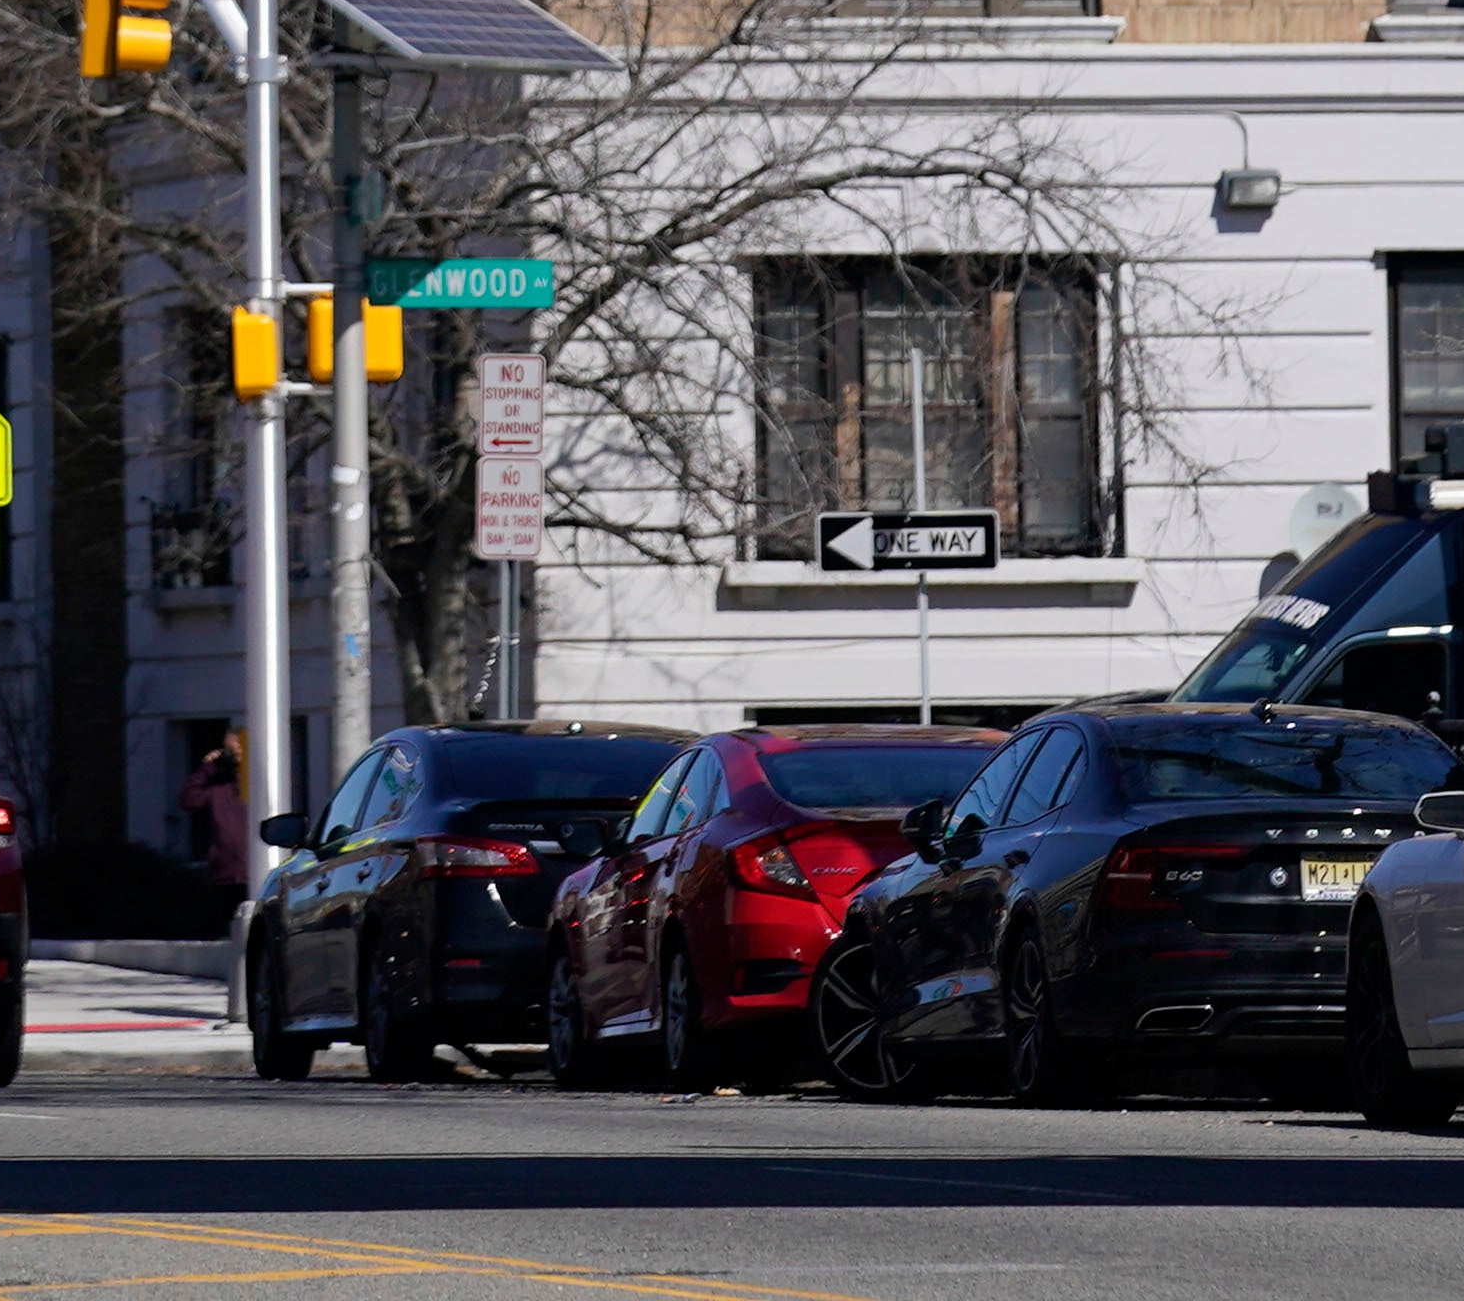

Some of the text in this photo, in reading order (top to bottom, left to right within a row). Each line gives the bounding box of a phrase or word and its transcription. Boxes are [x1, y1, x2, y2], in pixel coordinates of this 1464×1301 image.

[373, 268, 526, 297] GLENWOOD
[501, 364, 524, 382] NO
[485, 387, 541, 400] STOPPING
[504, 404, 521, 417] OR
[485, 421, 540, 434] STANDING
[502, 470, 521, 486] NO
[480, 491, 539, 507] PARKING
[873, 529, 979, 554] ONE WAY
[812, 866, 859, 875] CIVIC
[1308, 863, 1339, 886] M21
